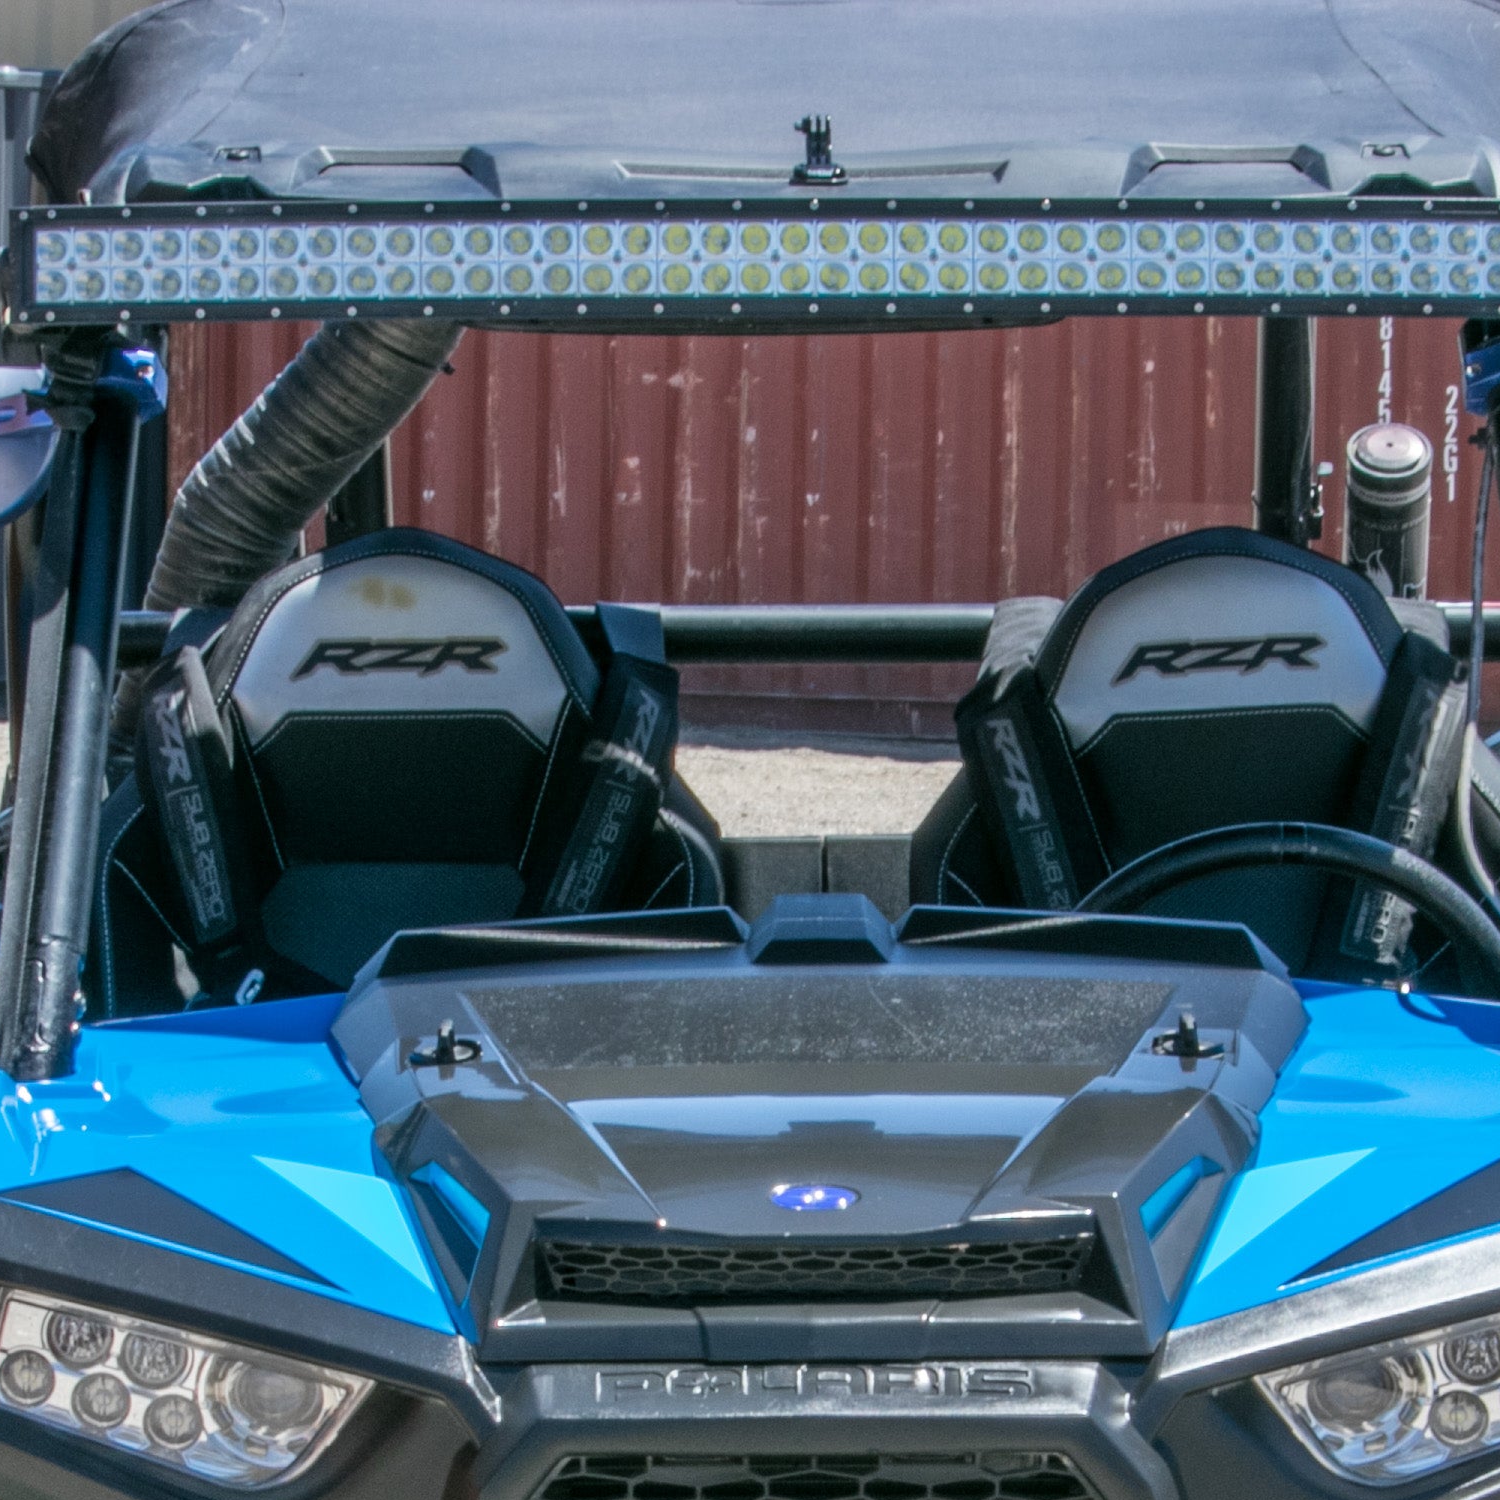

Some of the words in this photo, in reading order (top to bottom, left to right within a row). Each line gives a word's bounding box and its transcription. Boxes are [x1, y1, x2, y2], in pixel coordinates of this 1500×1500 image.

[1444, 385, 1458, 502] 22G1
[289, 636, 508, 682] RZR
[1110, 632, 1328, 688] RZR
[986, 718, 1042, 821] RZR
[601, 793, 633, 844] SUB
[198, 848, 225, 919] ZERO
[595, 1364, 1037, 1401] POLARIS
